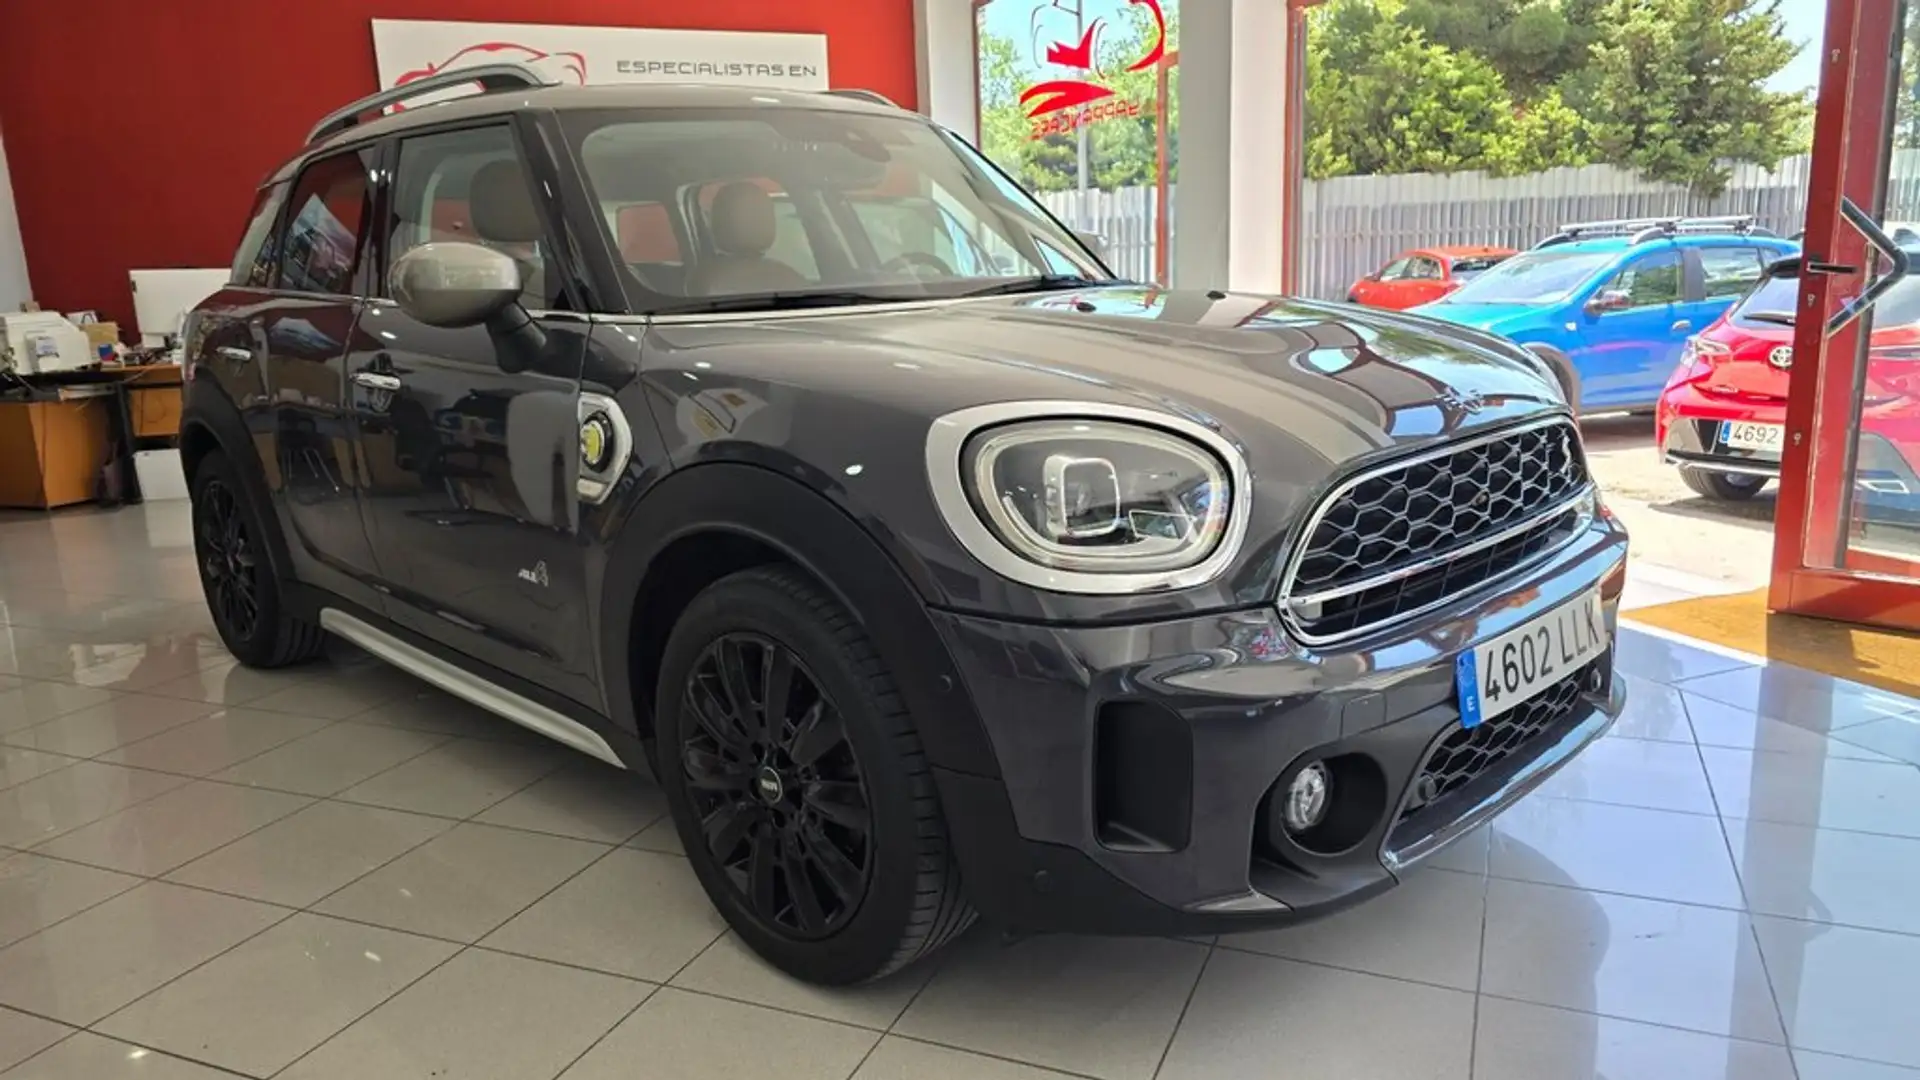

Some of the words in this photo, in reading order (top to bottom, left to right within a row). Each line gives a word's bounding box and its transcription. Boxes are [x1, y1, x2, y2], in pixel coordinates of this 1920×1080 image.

[616, 60, 784, 77] ESPECIALISTAS
[788, 65, 817, 77] EN
[1733, 424, 1778, 444] 4692
[1484, 625, 1553, 702] 4602
